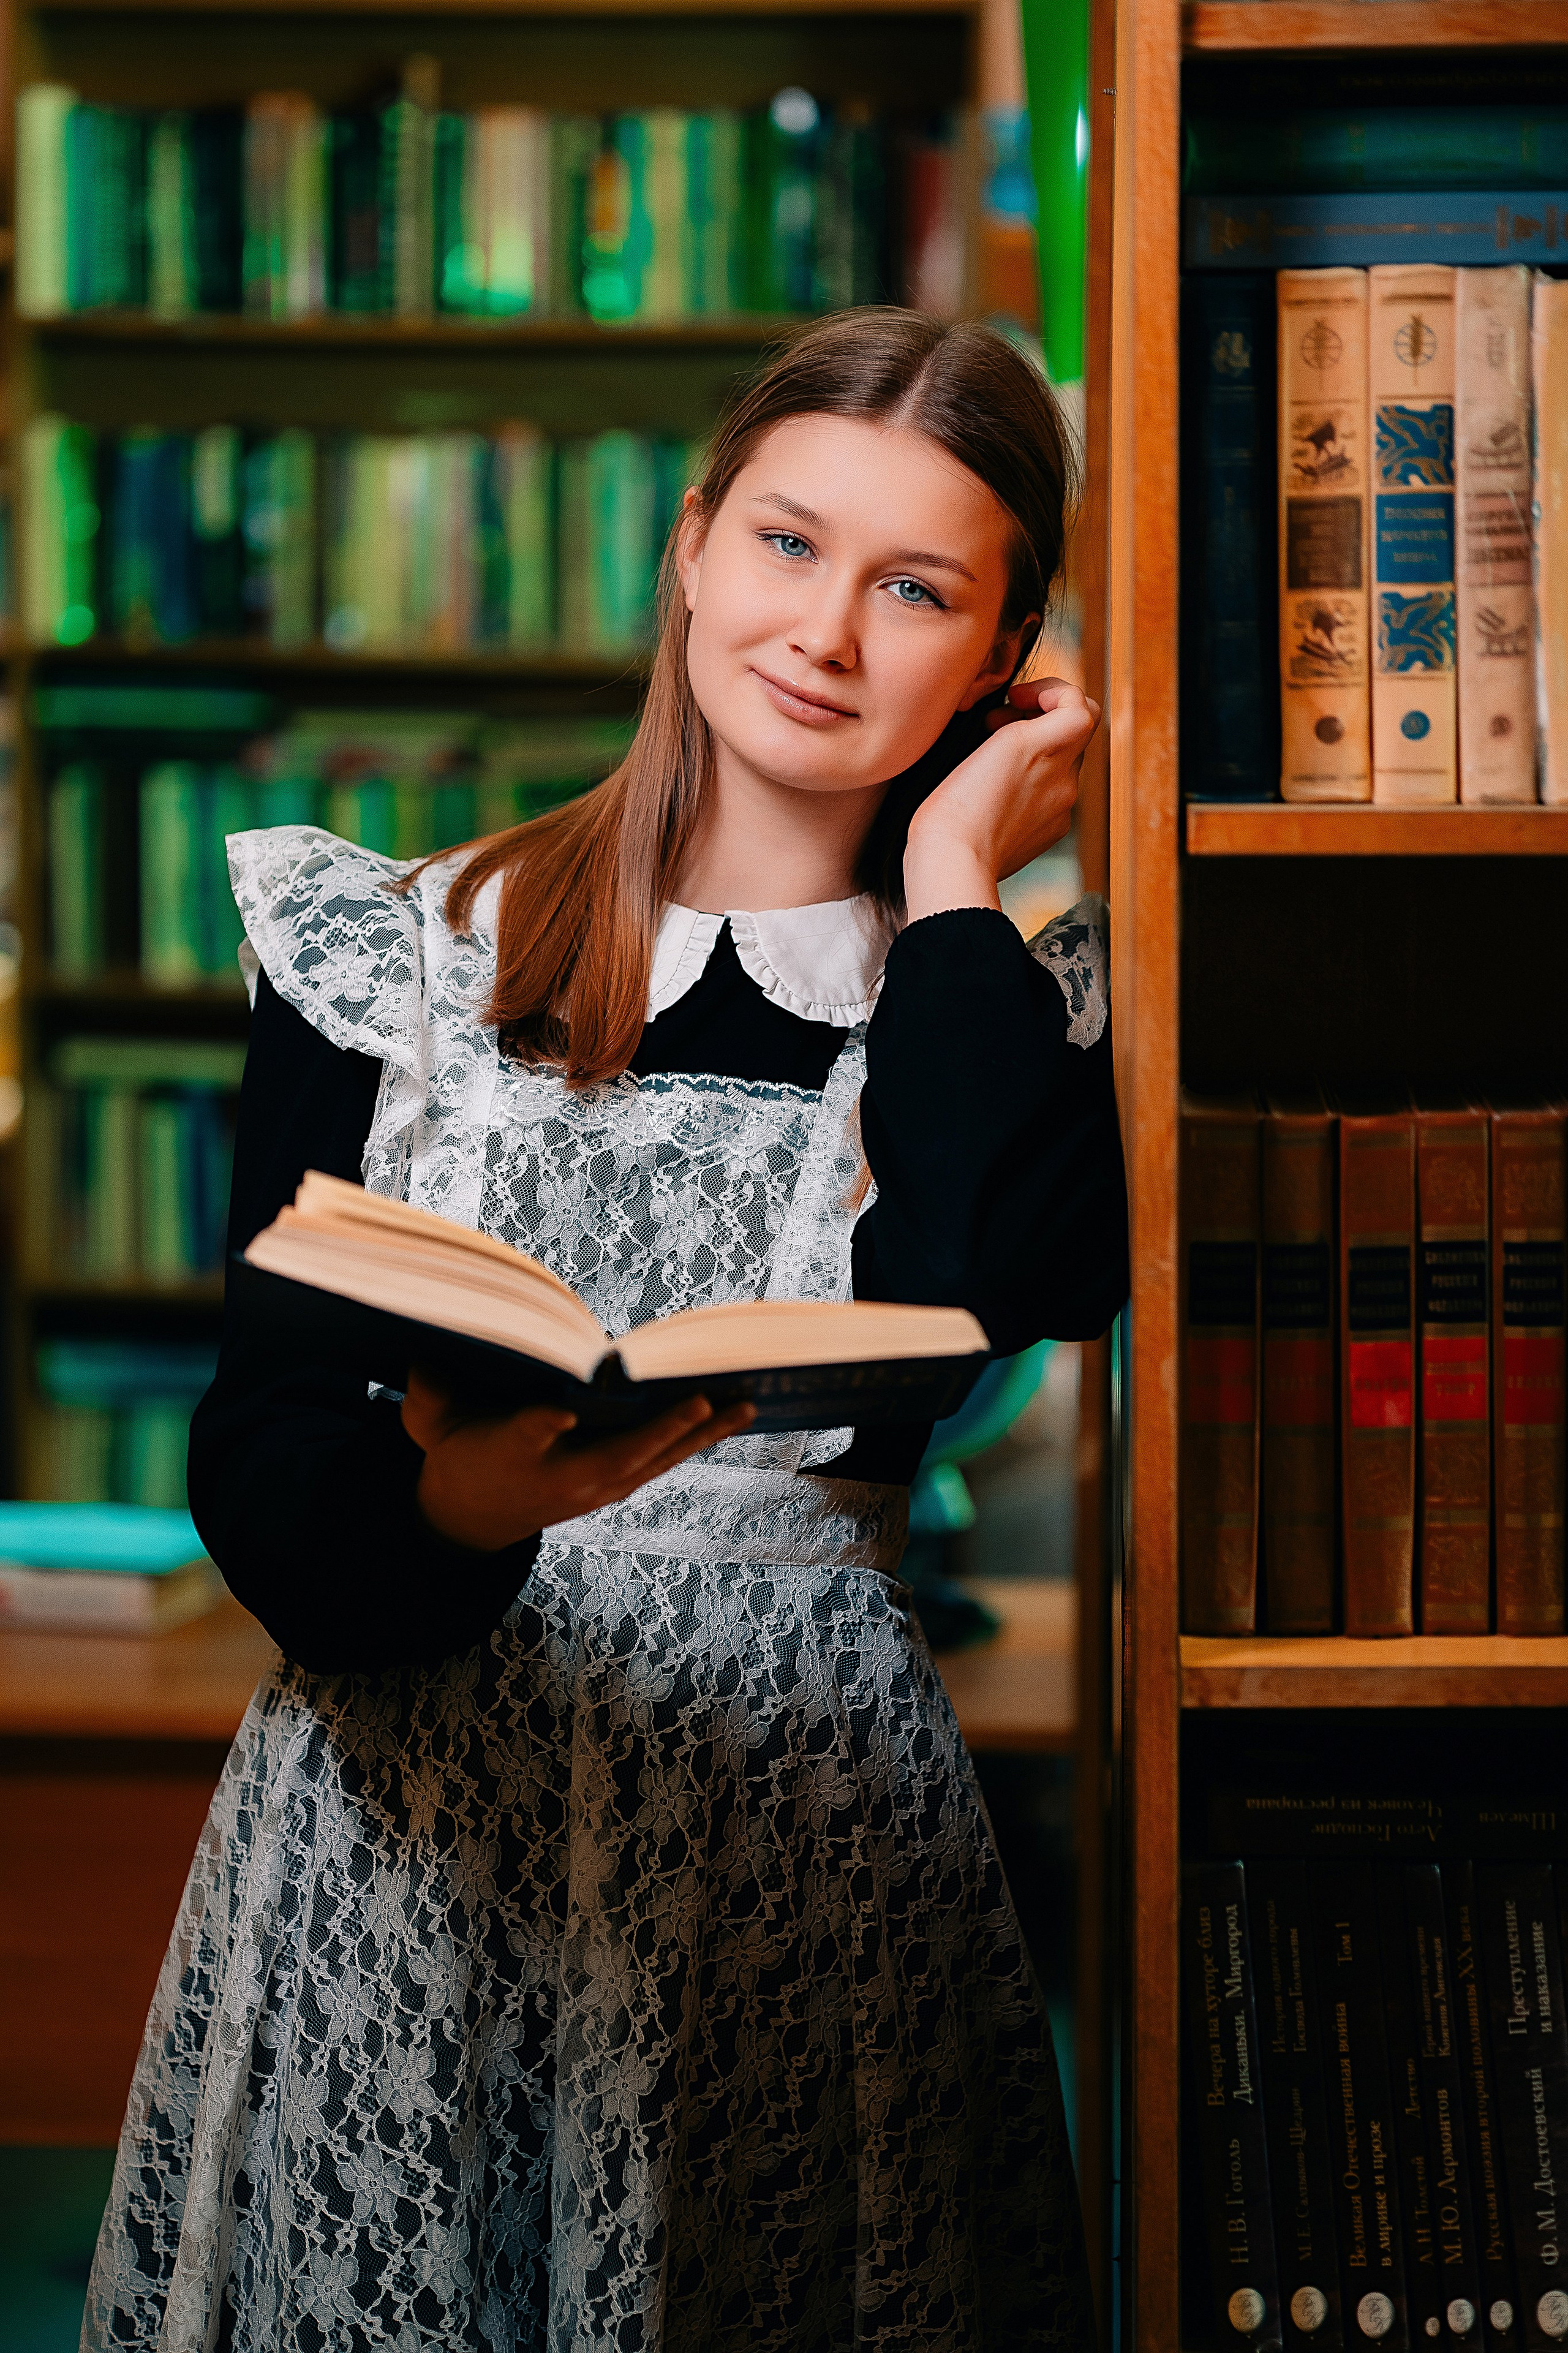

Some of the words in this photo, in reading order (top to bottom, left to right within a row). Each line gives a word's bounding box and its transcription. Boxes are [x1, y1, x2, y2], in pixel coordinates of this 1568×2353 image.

[1245, 1796, 1336, 1811] ресторана
[1341, 1798, 1362, 1811] из
[1311, 1821, 1391, 1842] Господне
[1396, 1823, 1443, 1843] Лето
[1197, 1906, 1213, 1949] близ
[1267, 1900, 1280, 1944] города
[1459, 1905, 1471, 1943] века
[1224, 1903, 1245, 1999] Миргород
[1271, 1946, 1283, 1992] одного
[1336, 1933, 1353, 1967] Том
[1433, 1936, 1446, 2003] Лиговская
[1505, 1900, 1530, 2036] Преступление
[1531, 1920, 1551, 2017] наказание
[1203, 1953, 1221, 2012] хуторе
[1421, 1978, 1432, 2022] нашего
[1208, 2017, 1220, 2038] на
[1272, 1994, 1286, 2053] История
[1292, 2000, 1308, 2053] Господа
[1331, 2001, 1350, 2053] война
[1422, 2023, 1437, 2057] Герой
[1438, 2004, 1452, 2057] Княгиня
[1465, 1983, 1484, 2066] половины
[1540, 2021, 1553, 2034] и
[1207, 2043, 1226, 2106] Вечера
[1232, 2009, 1254, 2105] Диканьки.
[1404, 2058, 1422, 2120] Детство
[1472, 2069, 1489, 2128] второй
[1339, 2057, 1361, 2190] Отечественная
[1370, 2119, 1387, 2170] прозе
[1436, 2087, 1459, 2194] Лермонтов
[1523, 2067, 1558, 2198] Достоевский
[1225, 2137, 1245, 2206] Гоголь
[1289, 2085, 1310, 2219] Салтыков-Щедрин
[1479, 2129, 1495, 2189] поэзия
[1373, 2174, 1385, 2186] и
[1410, 2155, 1429, 2221] Толстой
[1227, 2211, 1248, 2234] В.
[1349, 2194, 1368, 2267] Великая
[1375, 2191, 1394, 2253] лирике
[1439, 2197, 1461, 2232] Ю.
[1485, 2191, 1505, 2261] Русская
[1536, 2201, 1558, 2232] М.
[1229, 2238, 1250, 2265] Н.
[1381, 2256, 1393, 2267] в
[1442, 2235, 1463, 2265] М.
[1539, 2235, 1560, 2267] Ф.
